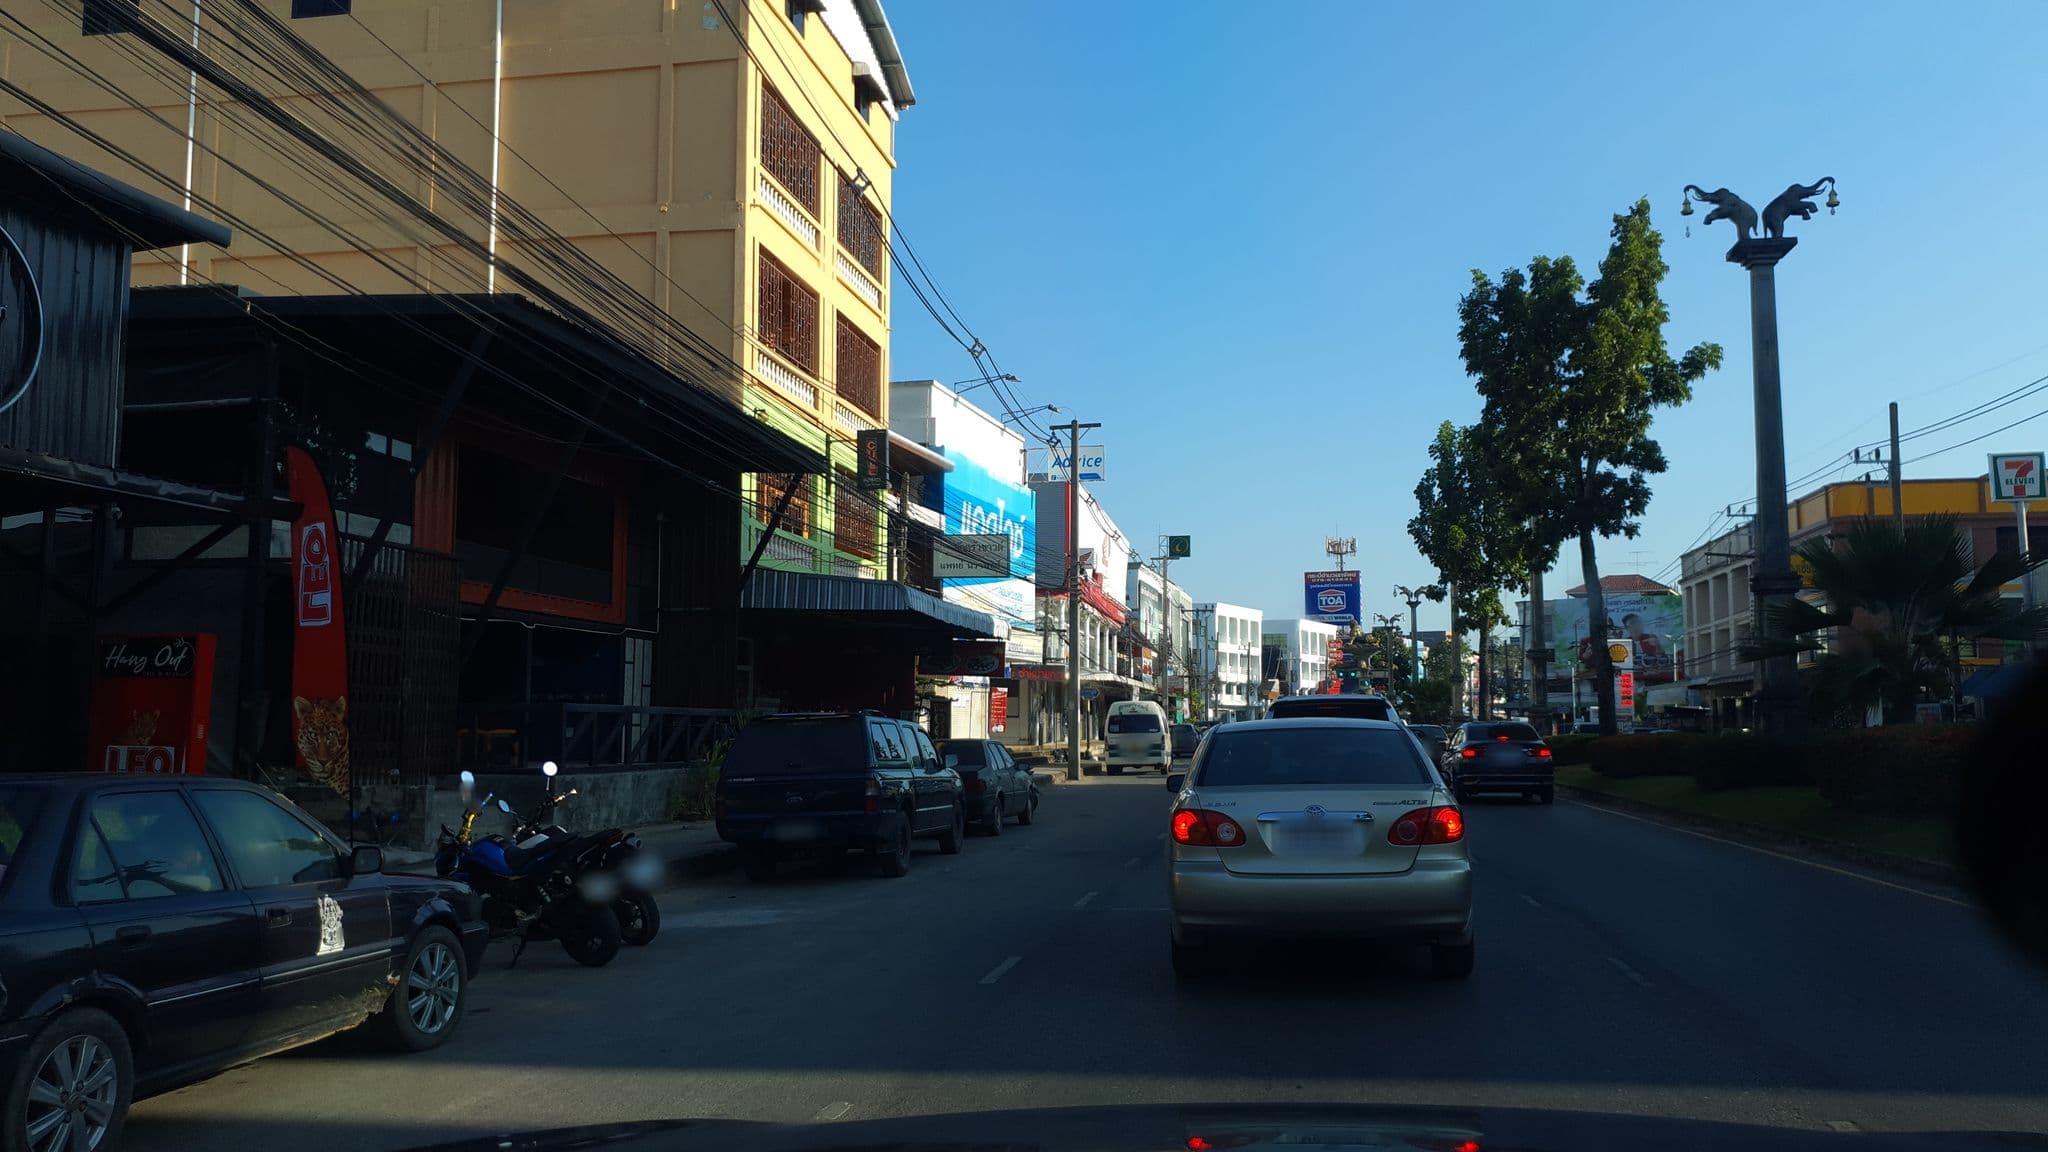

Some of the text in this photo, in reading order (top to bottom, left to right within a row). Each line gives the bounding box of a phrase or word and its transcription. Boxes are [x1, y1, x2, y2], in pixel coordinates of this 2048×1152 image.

[1052, 455, 1103, 469] Adice
[2005, 460, 2033, 496] 7
[300, 522, 332, 626] LEO
[1319, 596, 1344, 606] TOA
[105, 644, 187, 672] Hang Out
[106, 746, 175, 774] LEO
